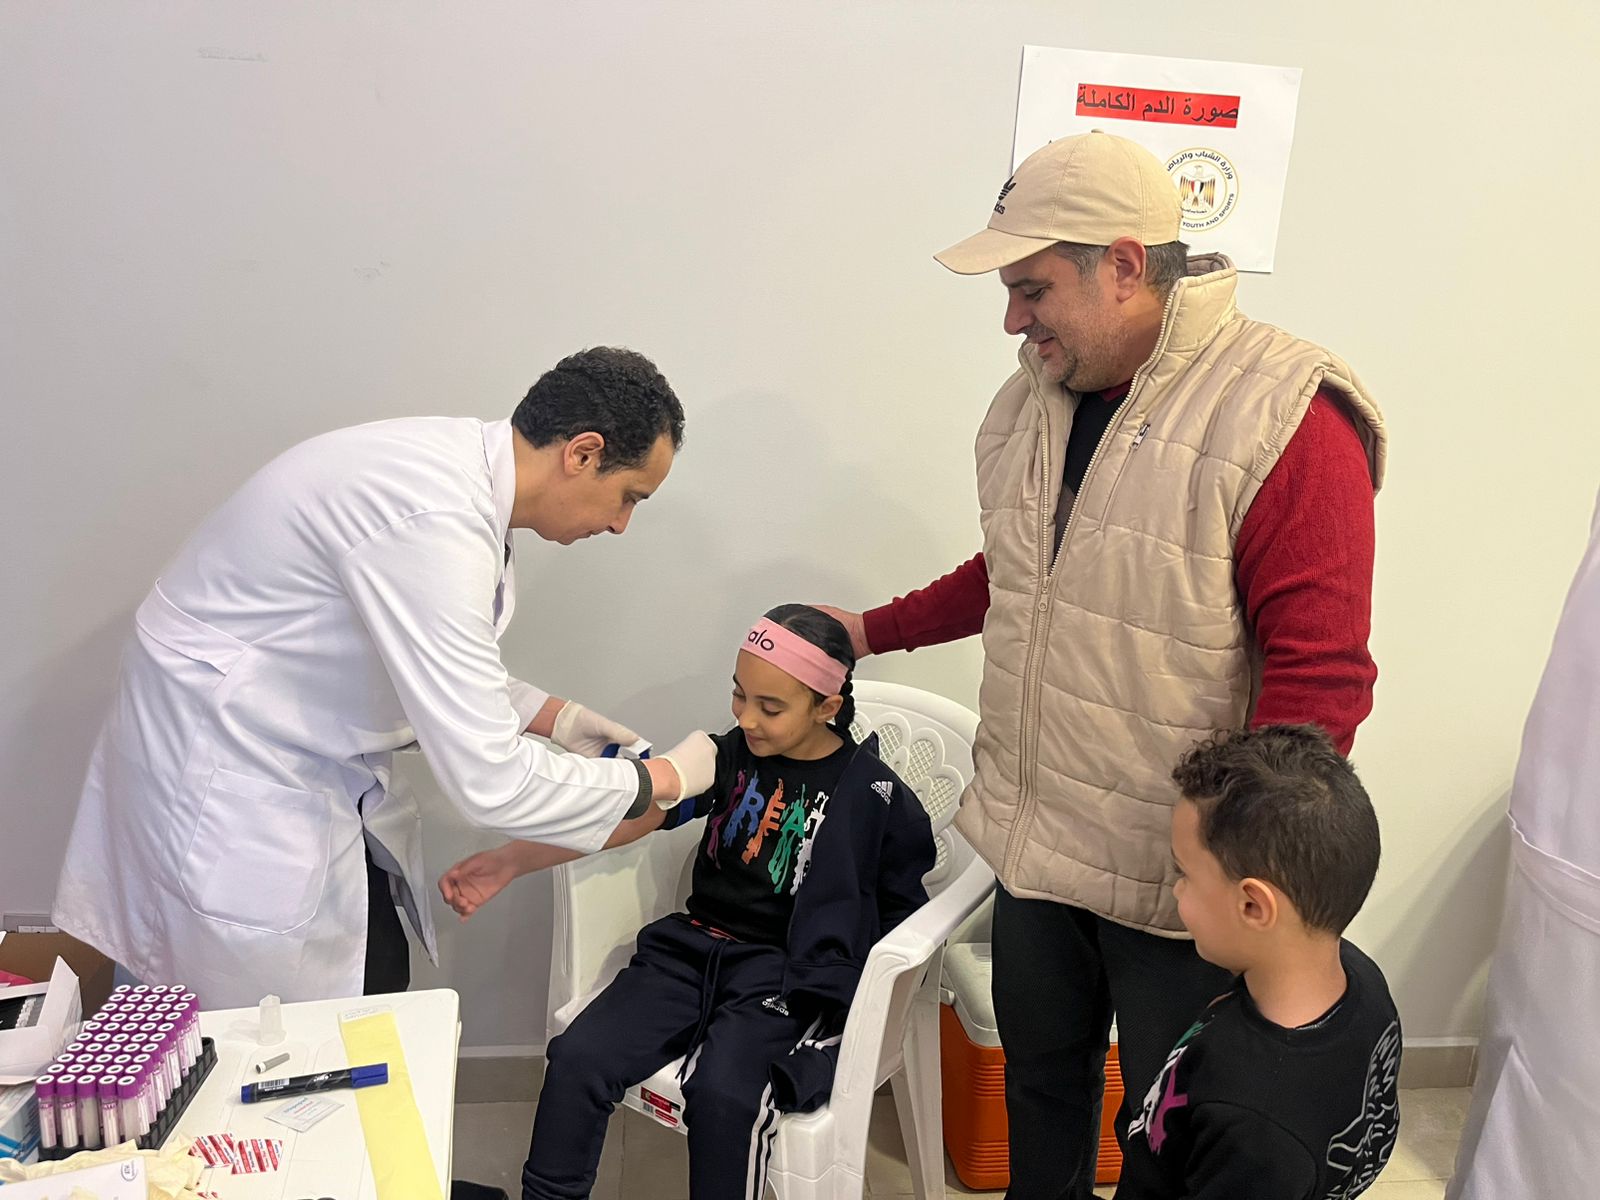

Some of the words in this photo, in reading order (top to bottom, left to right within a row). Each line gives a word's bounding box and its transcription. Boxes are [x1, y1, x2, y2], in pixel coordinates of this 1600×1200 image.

[1076, 85, 1136, 112] الكاملة
[1142, 95, 1175, 121] الدم
[1183, 97, 1239, 123] صورة
[1167, 152, 1193, 172] والرياض
[748, 629, 775, 651] alo
[870, 782, 891, 805] adidas
